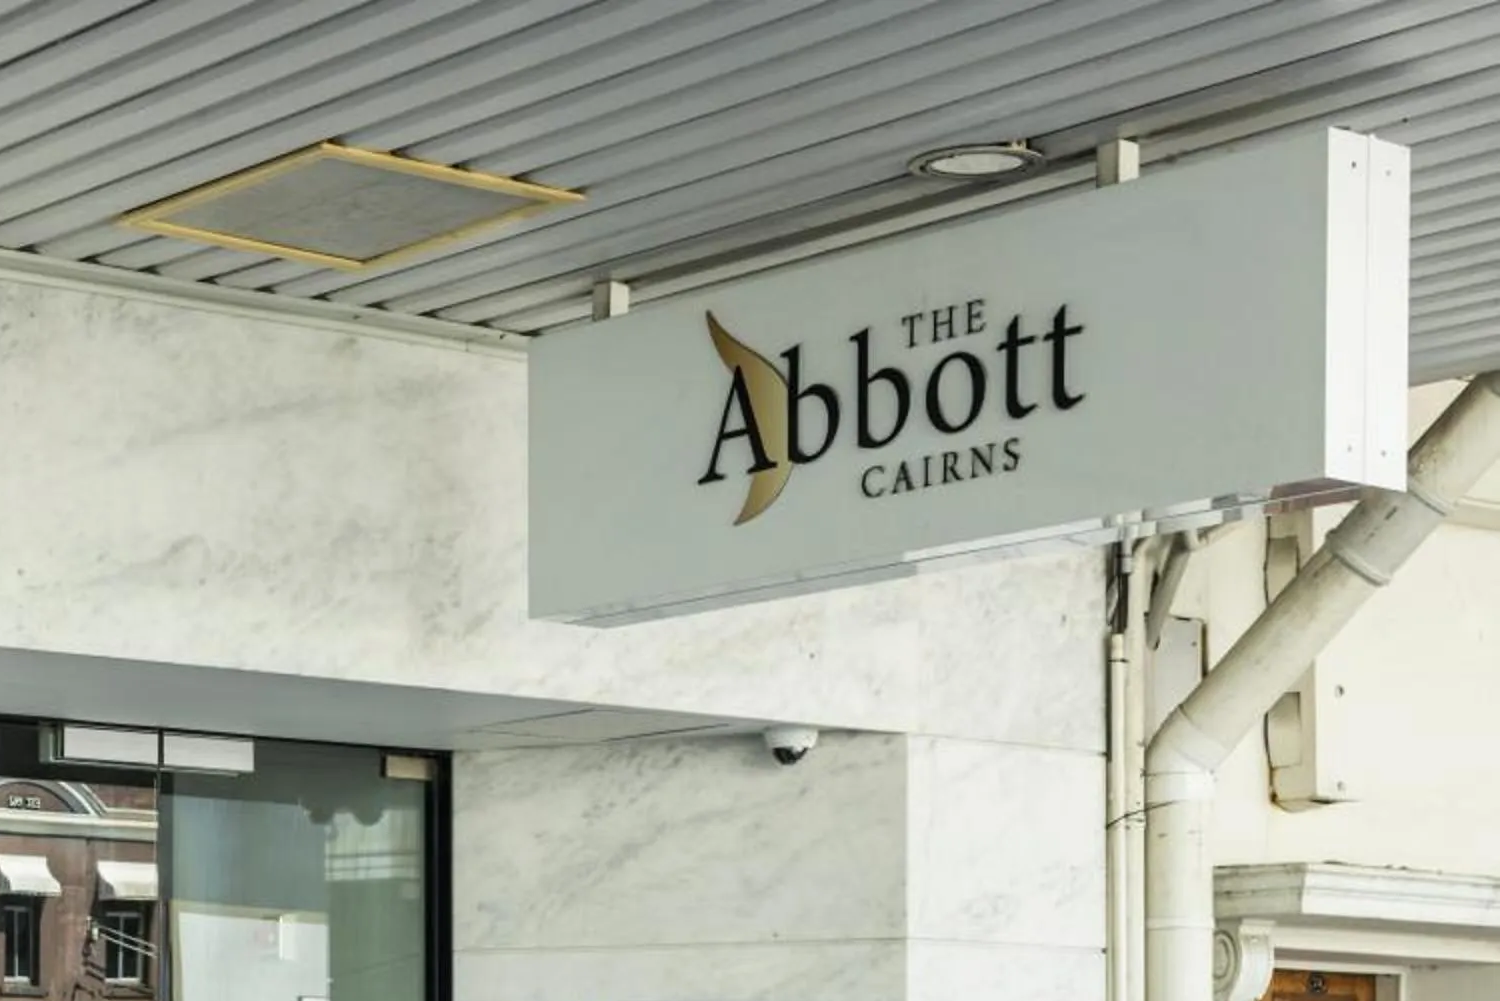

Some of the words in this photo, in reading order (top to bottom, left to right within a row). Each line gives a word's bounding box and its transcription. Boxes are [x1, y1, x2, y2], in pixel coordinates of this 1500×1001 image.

[902, 299, 987, 348] THE
[698, 303, 1086, 486] Abbott
[861, 438, 1021, 498] CAIRNS
